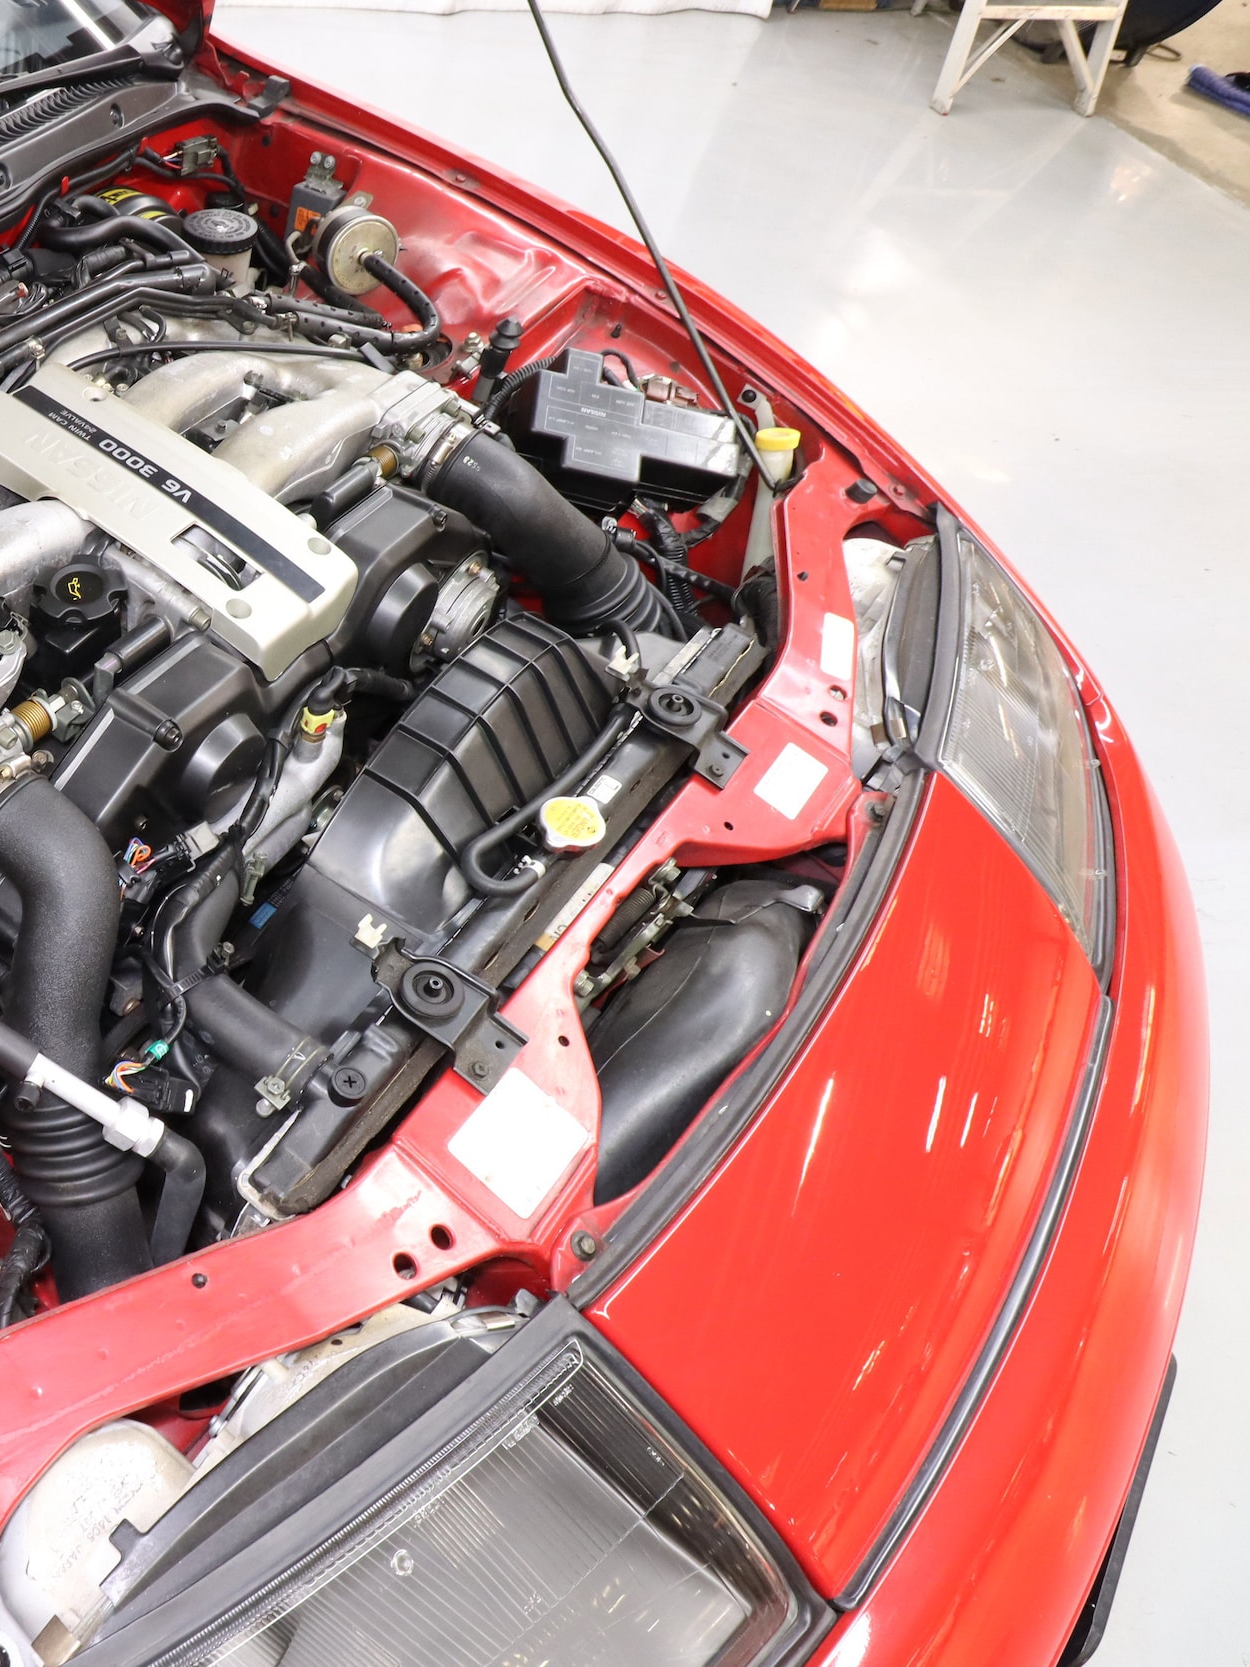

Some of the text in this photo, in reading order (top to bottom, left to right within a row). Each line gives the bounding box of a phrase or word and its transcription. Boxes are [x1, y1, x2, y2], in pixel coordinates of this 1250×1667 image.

[48, 411, 92, 441] TWIN CAM
[60, 409, 97, 433] 24VALVE
[25, 432, 158, 520] NISSAN
[99, 439, 192, 503] V6 3000
